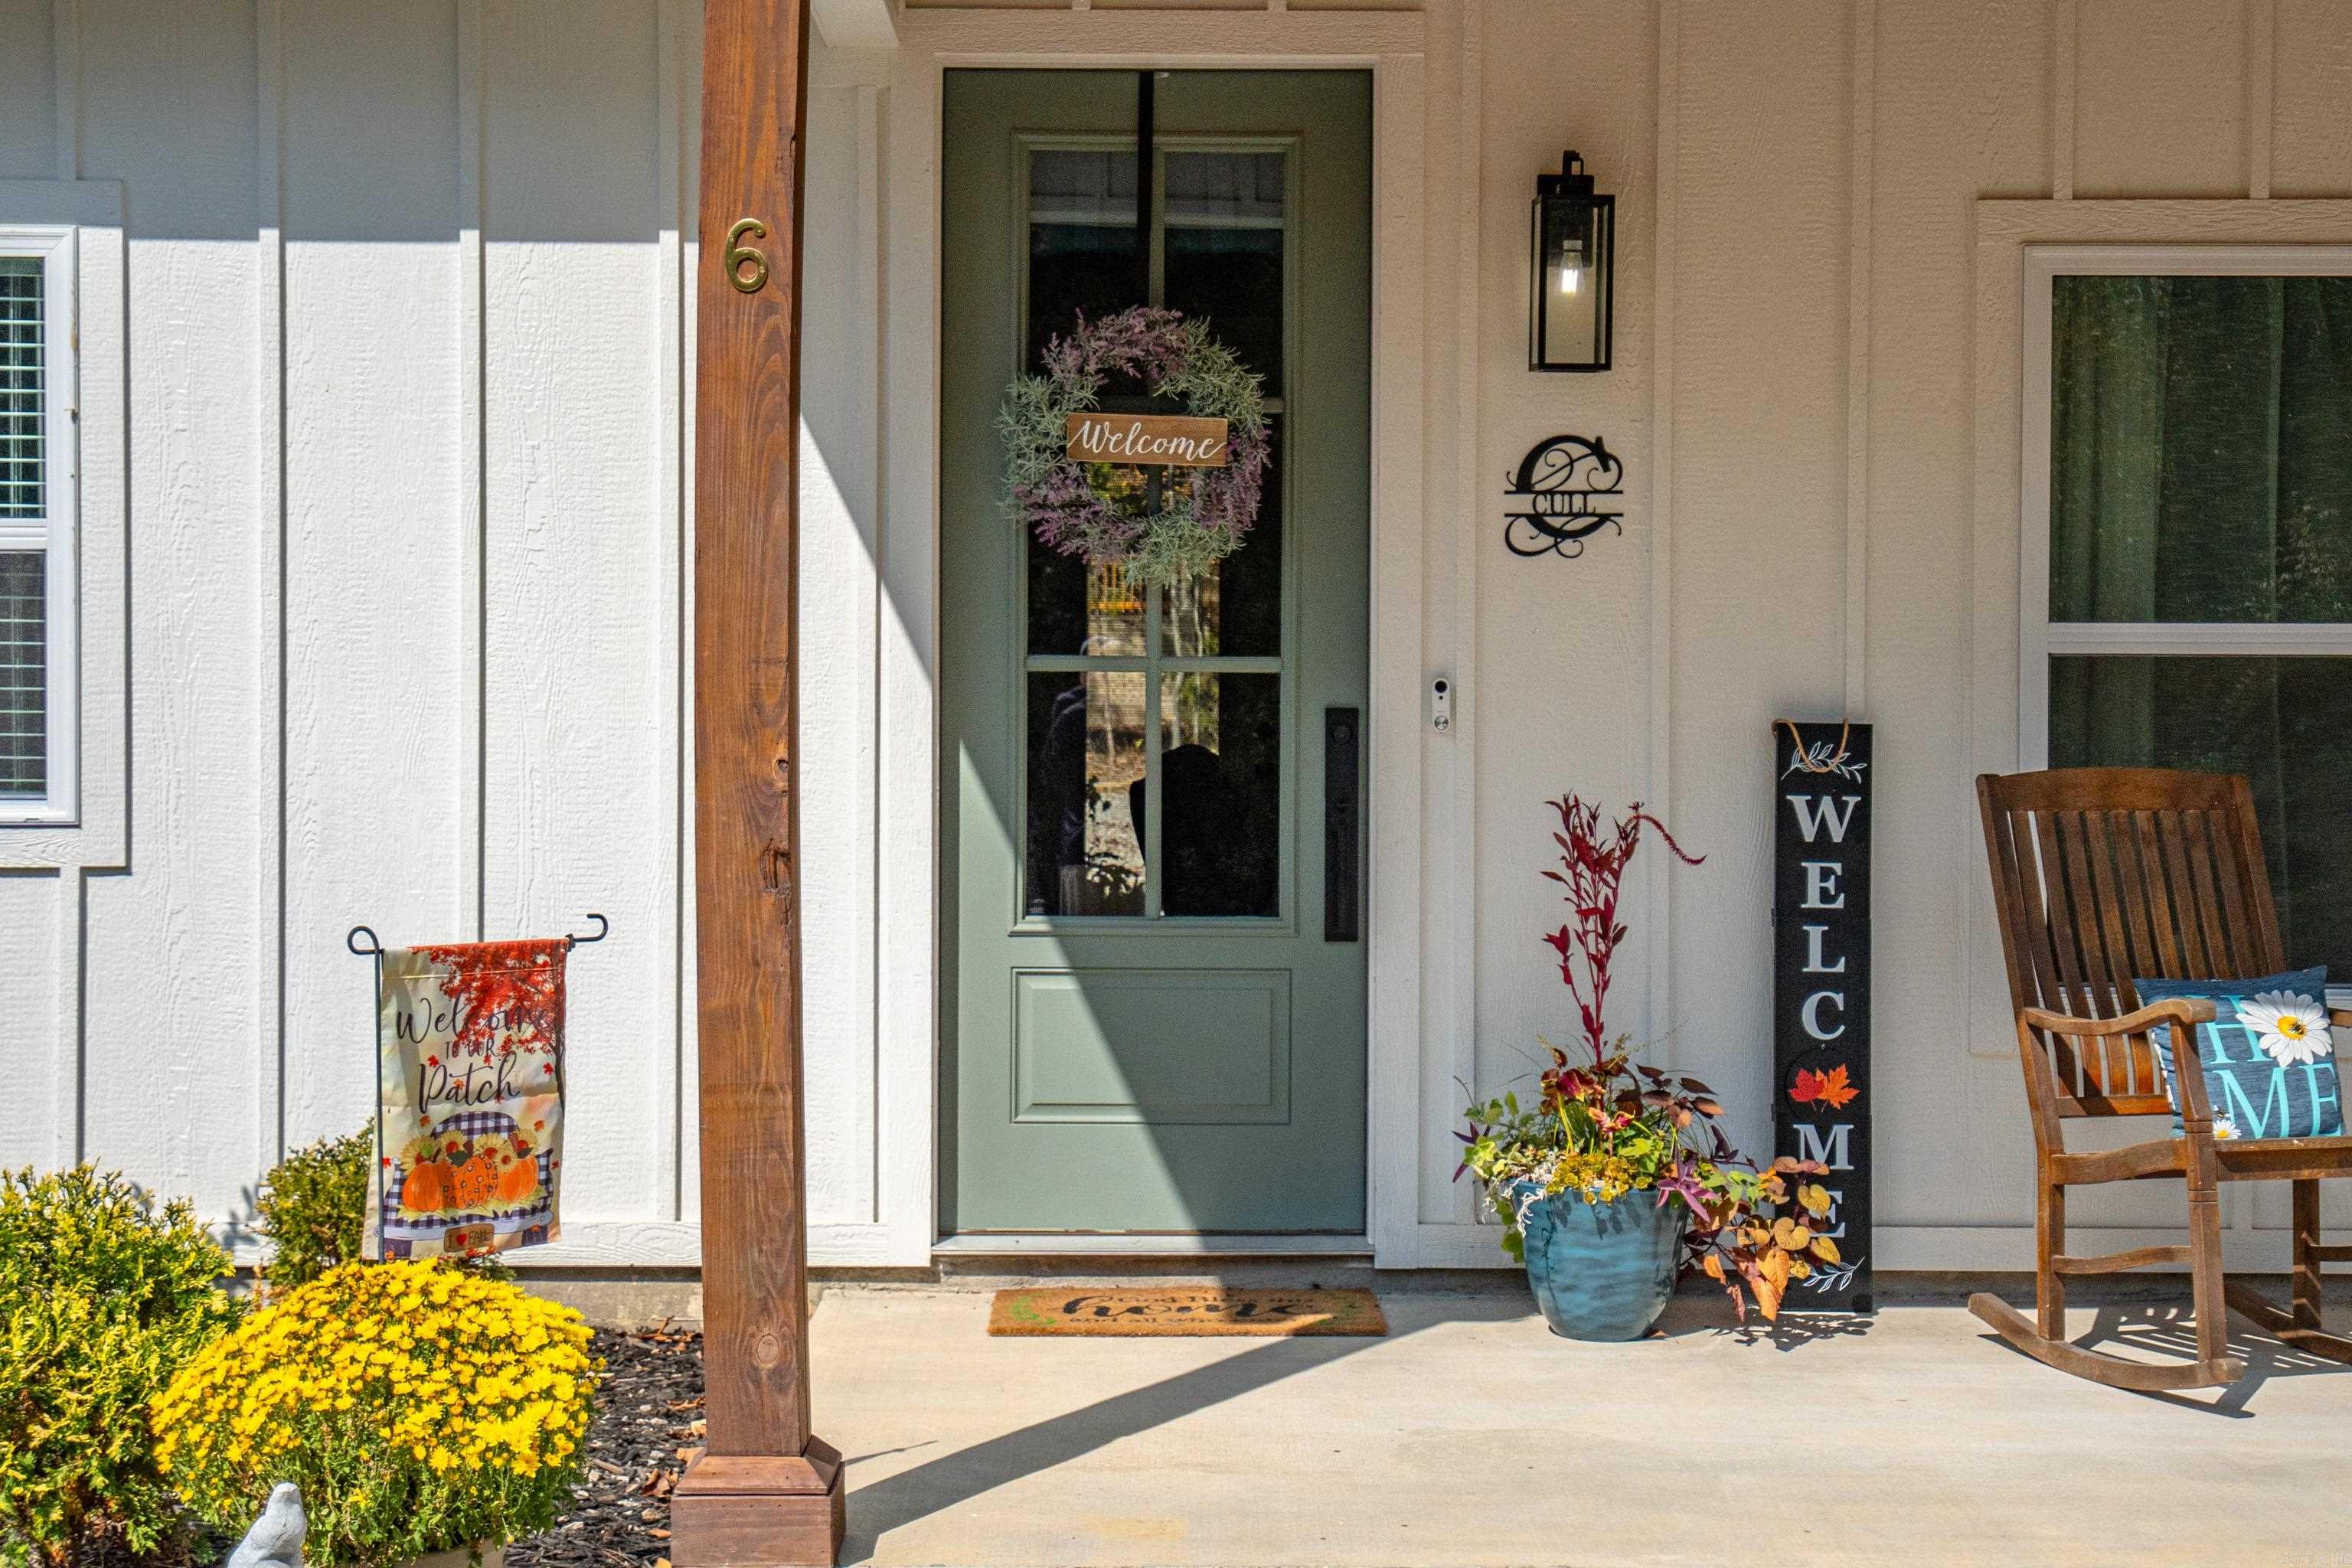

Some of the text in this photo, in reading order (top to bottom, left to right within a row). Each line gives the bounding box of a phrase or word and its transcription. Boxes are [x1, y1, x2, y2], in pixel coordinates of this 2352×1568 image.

[725, 217, 768, 292] 6
[1067, 420, 1227, 461] Welcome
[419, 1050, 521, 1114] Patch
[1046, 1295, 1323, 1318] home
